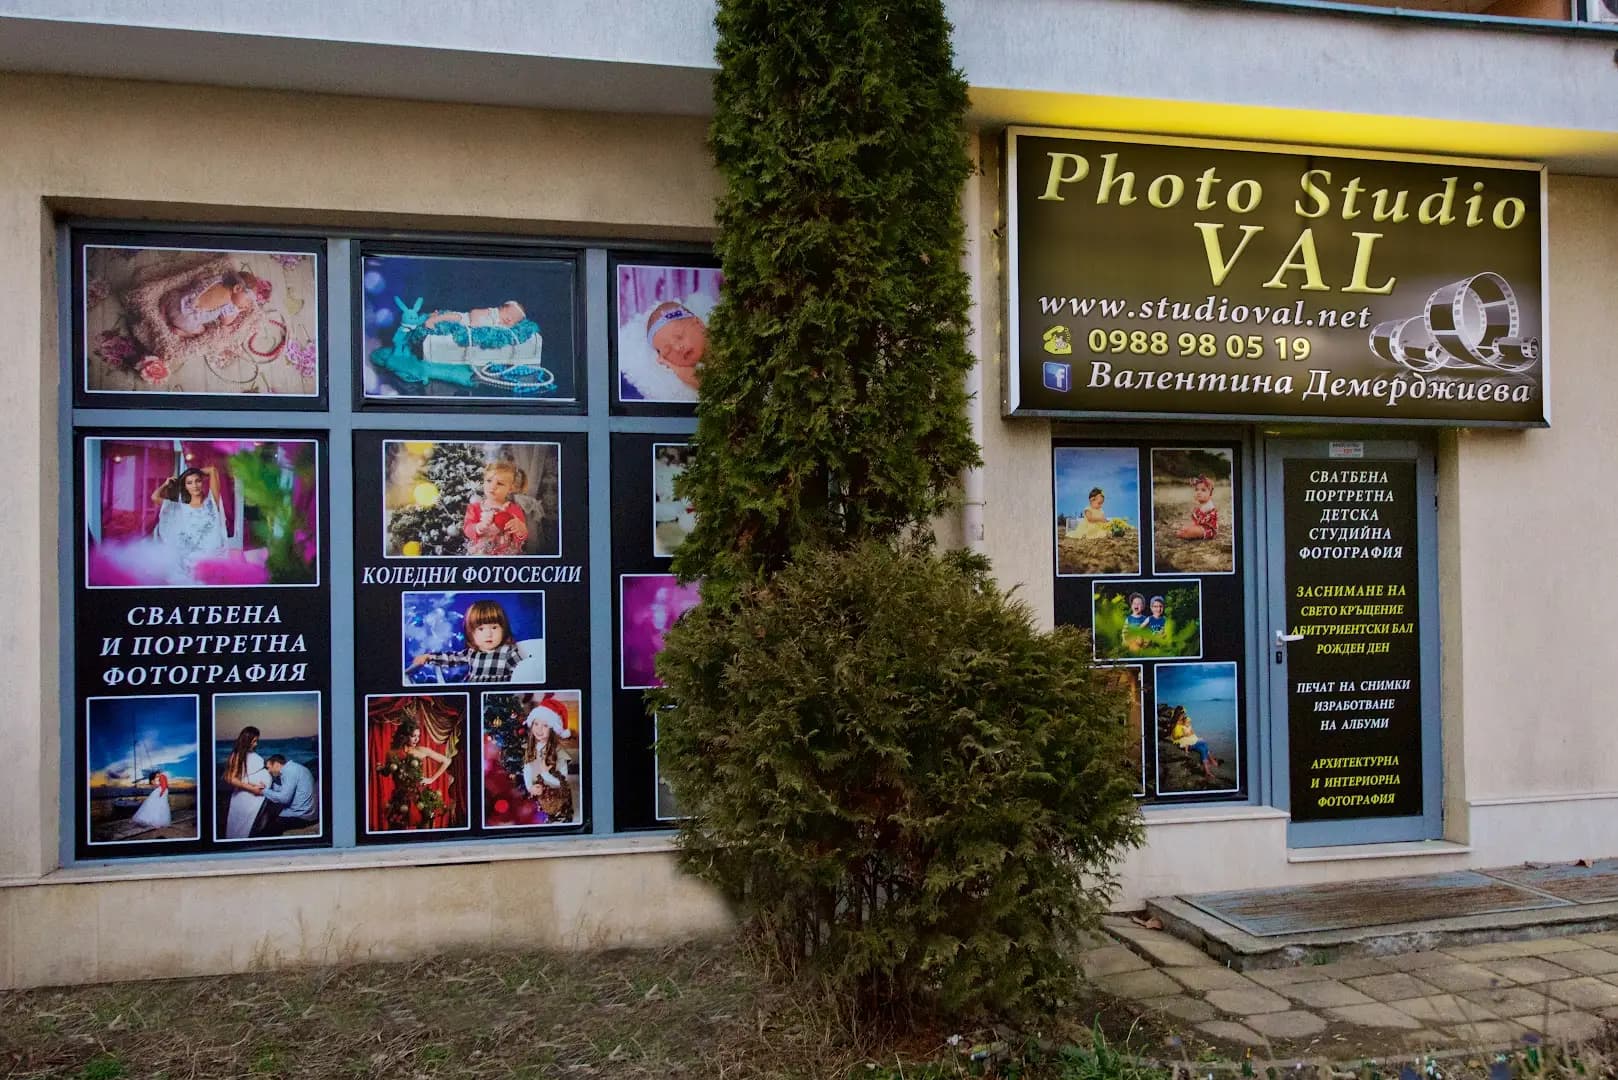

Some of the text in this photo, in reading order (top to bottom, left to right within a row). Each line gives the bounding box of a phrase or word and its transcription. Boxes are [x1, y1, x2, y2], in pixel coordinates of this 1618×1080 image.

[1038, 151, 1526, 230] Photo Studio
[1194, 222, 1398, 295] VAL
[1038, 295, 1371, 329] www.studioval.net
[1088, 329, 1311, 361] 0988 98 05 19
[1087, 362, 1531, 407] Валентина Демерджиева
[1310, 471, 1388, 483] СВАТБЕНА
[1304, 490, 1394, 502] ПОРТРЕТНА
[1320, 509, 1379, 523] ДЕТСКА
[1309, 526, 1392, 542] СТУДИЙНА
[1299, 547, 1403, 559] ФОТОГРАФИЯ
[362, 564, 582, 586] КОЛЕДНИ ФОТОСЕСИИ
[1297, 585, 1406, 597] ЗАСНИМАНЕ НА
[127, 605, 282, 627] СВАТБЕНА
[1301, 605, 1404, 616] СВЕТО КРЪЩЕНИЕ
[1292, 623, 1414, 635] АБИТУРИЕНТСКИ БАЛ
[100, 633, 307, 656] И ПОРТРЕТНА
[1317, 643, 1390, 655] РОЖДЕН ДЕН
[102, 662, 307, 687] ФОТОГРАФИЯ
[1297, 680, 1411, 693] ПЕЧАТ НА СНИМКИ
[1314, 699, 1395, 712] ИЗРАБОТВАНЕ
[1320, 718, 1389, 730] НА АЛБУМИ
[1311, 756, 1399, 769] АРХИТЕКТУРНА
[1311, 775, 1400, 788] И ИНТЕРИОРНА
[1318, 793, 1395, 807] ФОТОГРАФИЯ
